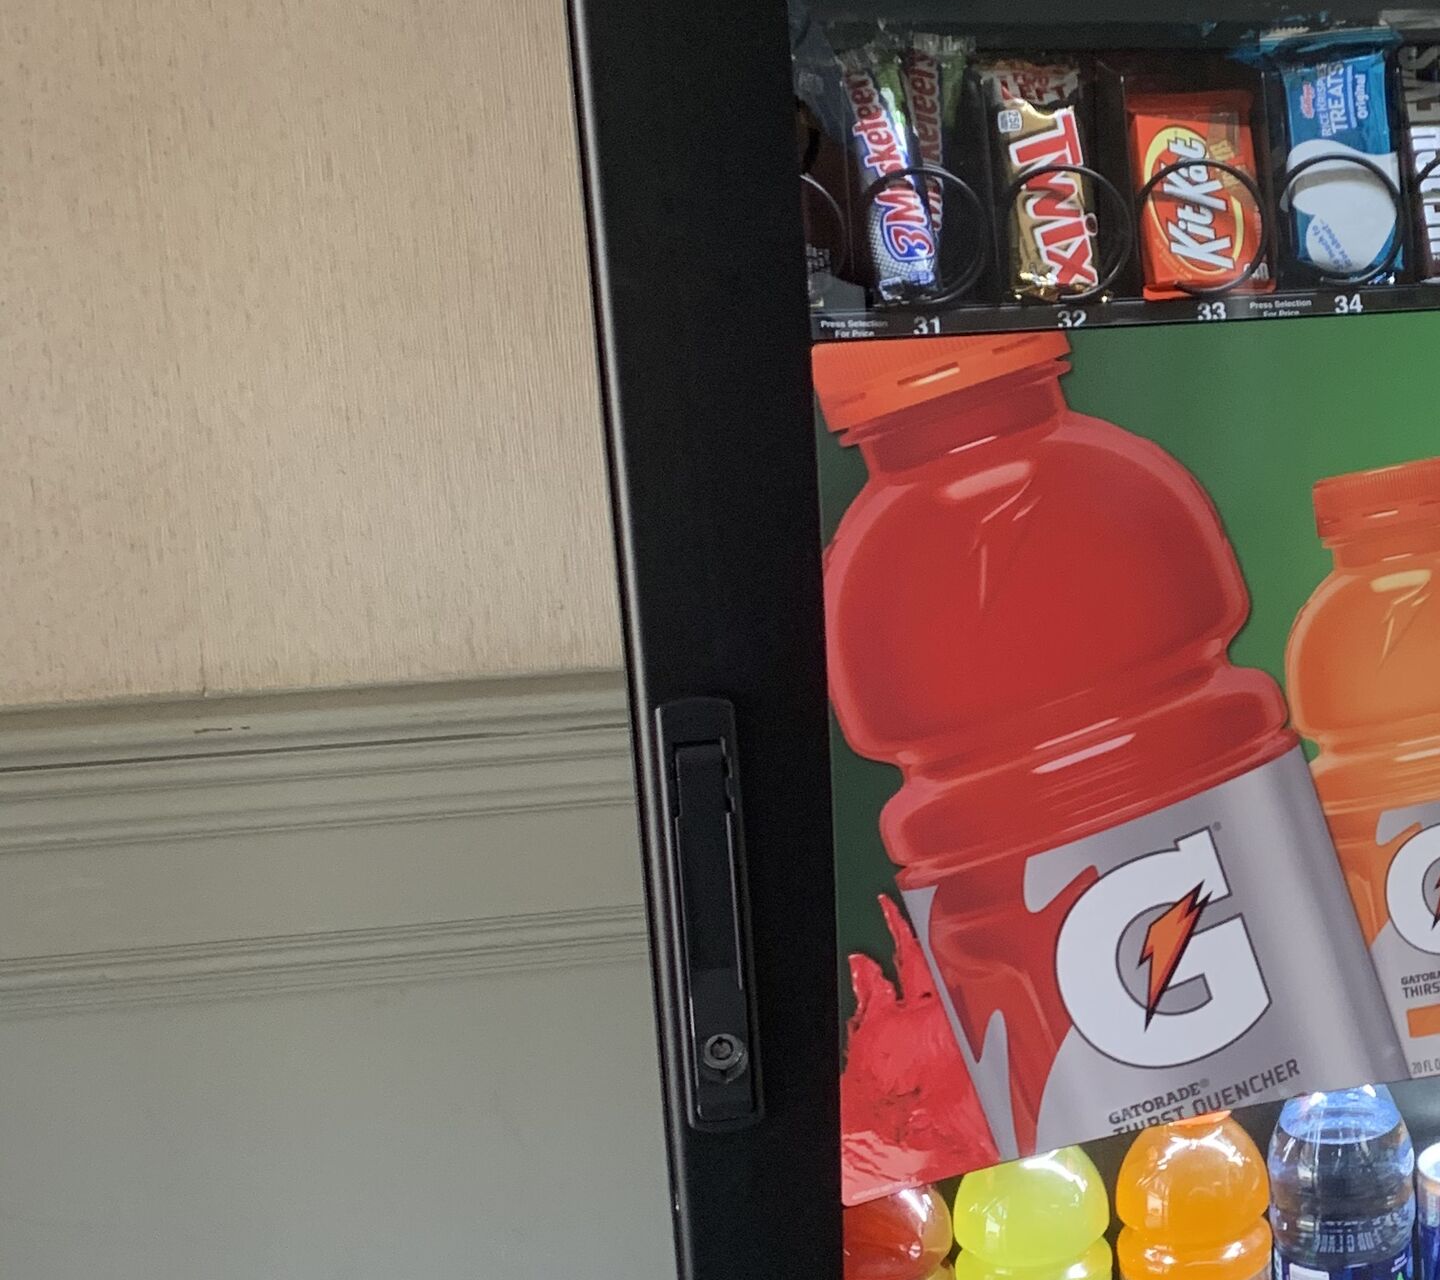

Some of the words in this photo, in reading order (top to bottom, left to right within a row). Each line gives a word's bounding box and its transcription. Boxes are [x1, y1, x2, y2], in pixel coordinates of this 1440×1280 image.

[1334, 293, 1363, 314] 34
[914, 317, 941, 335] 31
[1055, 827, 1273, 1069] G
[1107, 1081, 1201, 1126] GATORADE
